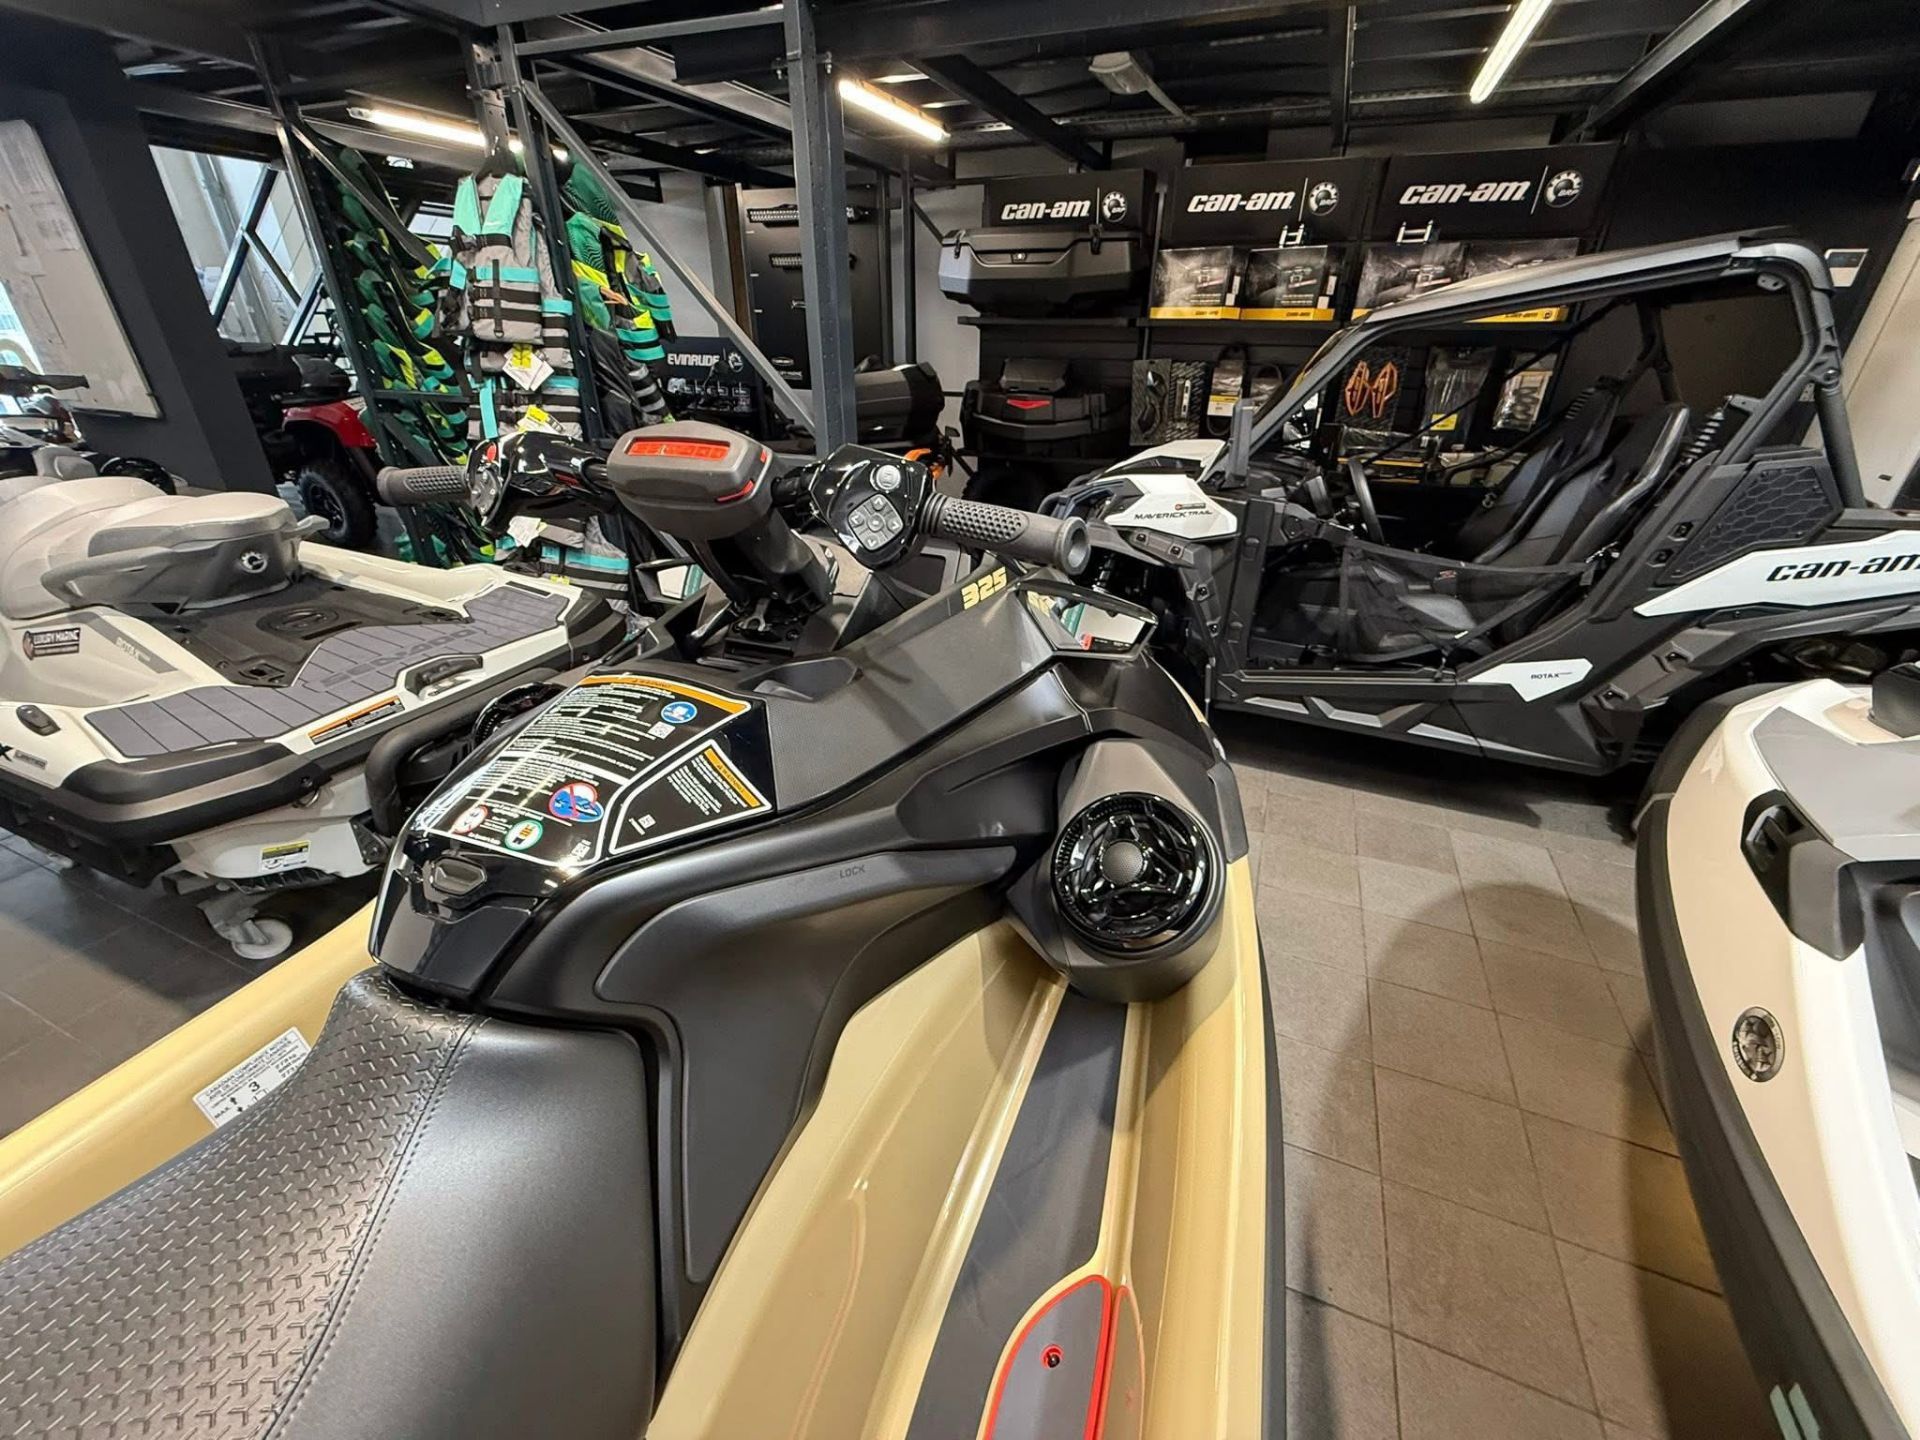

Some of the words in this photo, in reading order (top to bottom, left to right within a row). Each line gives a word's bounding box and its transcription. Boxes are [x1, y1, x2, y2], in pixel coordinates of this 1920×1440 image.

[1400, 181, 1531, 205] can-am
[1001, 200, 1091, 220] can-am
[1187, 191, 1296, 213] can-am
[667, 353, 720, 367] EVINRUDE
[1134, 511, 1187, 521] MAVERICK
[1766, 553, 1920, 582] can-am
[961, 566, 1008, 611] 325
[1530, 672, 1560, 680] ROTAX
[839, 864, 866, 879] LOCK
[248, 1081, 261, 1093] 3
